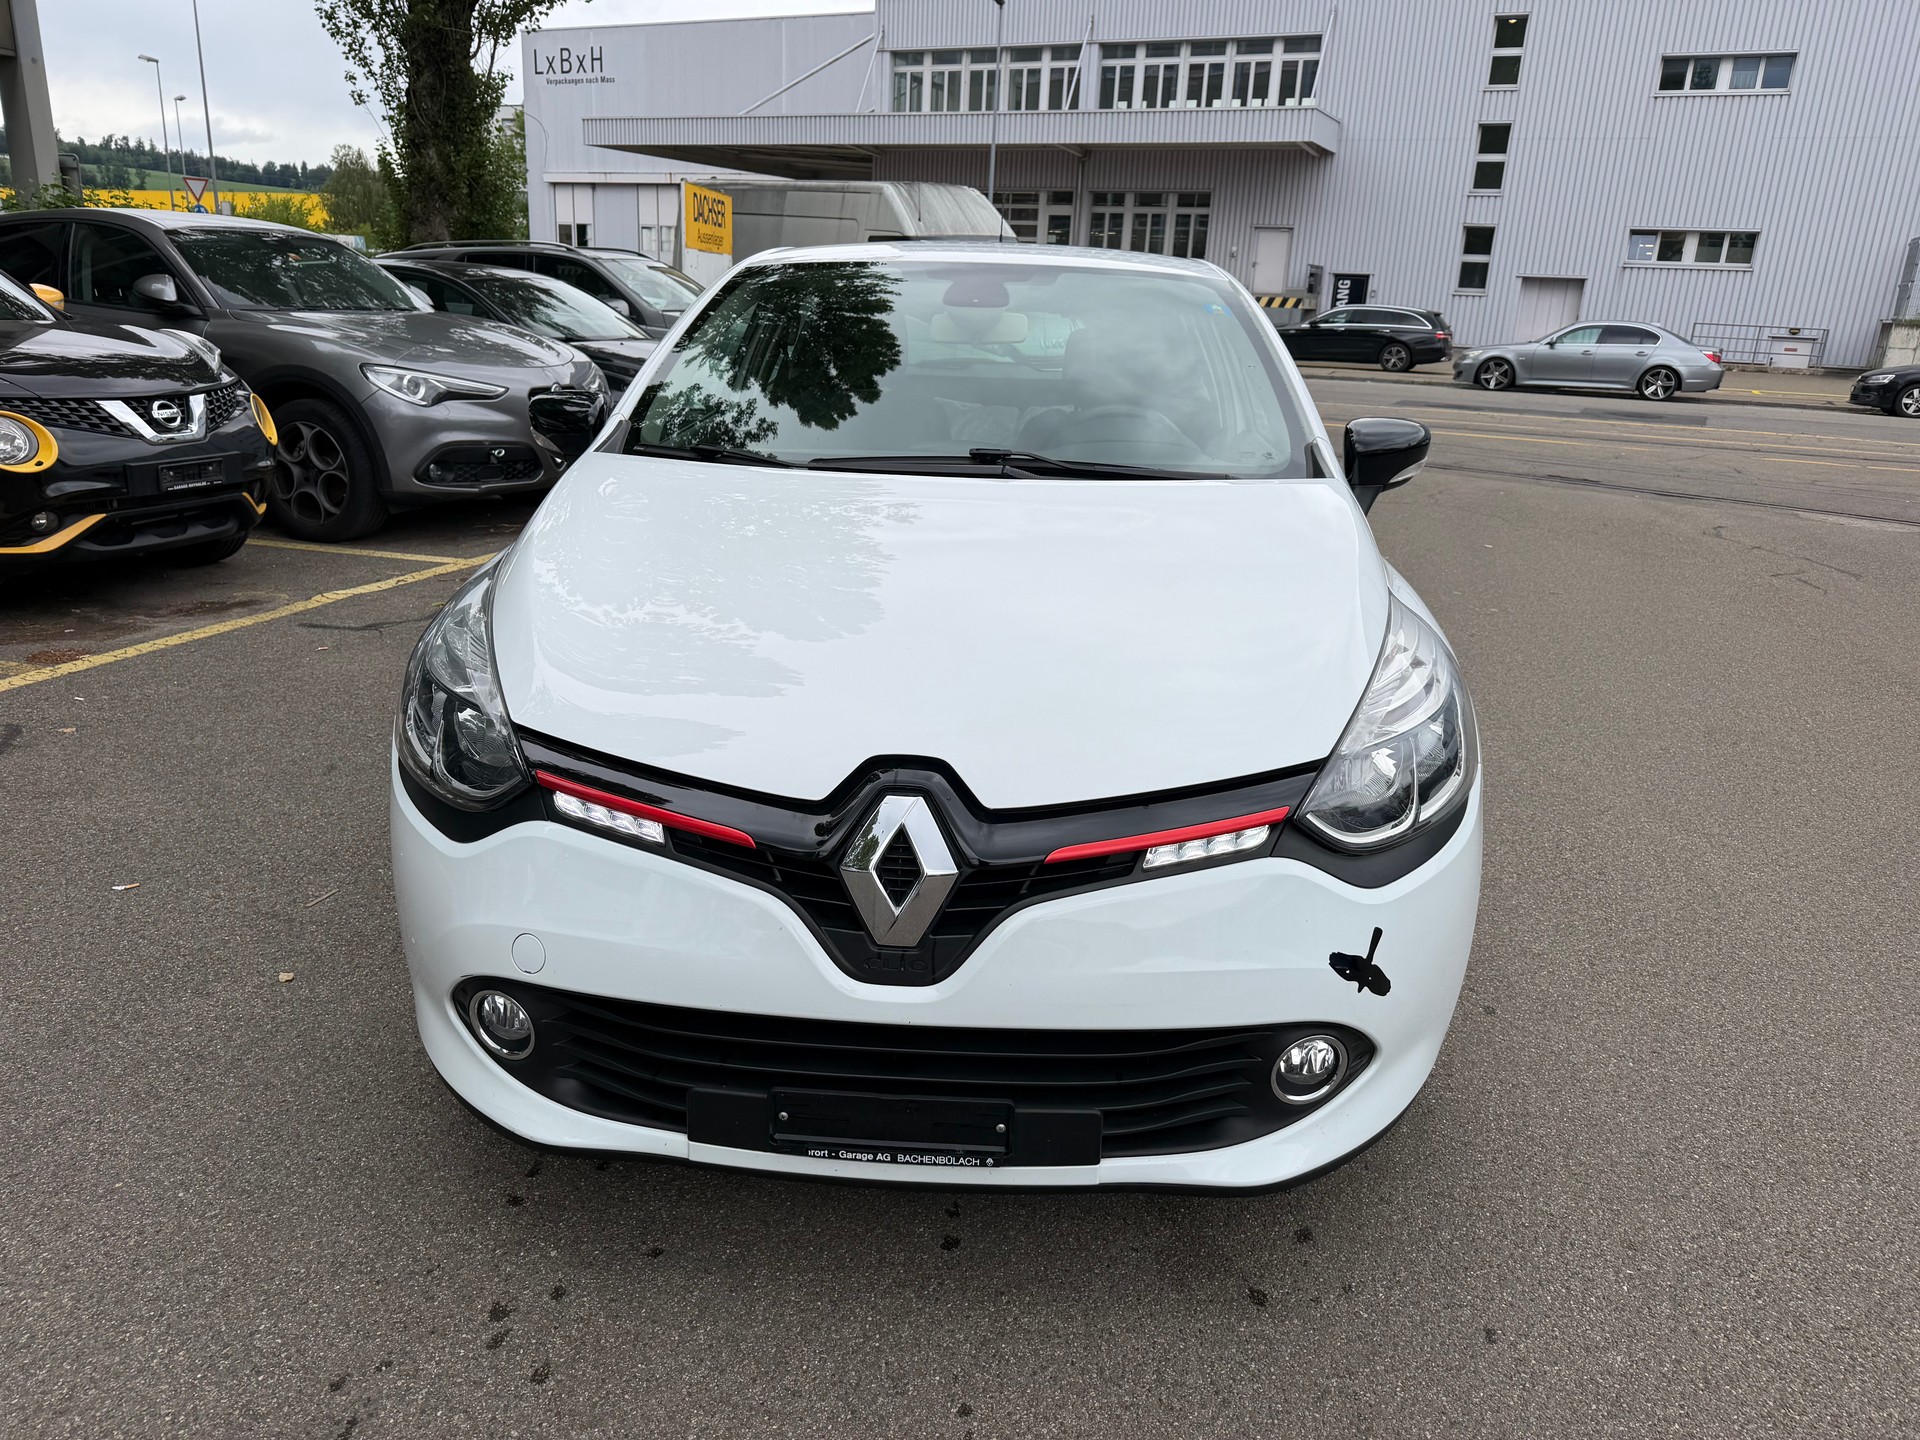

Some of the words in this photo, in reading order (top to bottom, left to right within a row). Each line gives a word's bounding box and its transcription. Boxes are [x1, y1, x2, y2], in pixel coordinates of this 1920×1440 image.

[533, 46, 603, 75] LxBxH
[546, 77, 584, 86] Verpackungen
[586, 76, 599, 84] nach
[600, 75, 616, 84] Mass
[693, 191, 726, 229] DACHSER
[697, 228, 724, 250] Aussenlager
[838, 1150, 874, 1161] Garage
[876, 1153, 891, 1161] AG
[897, 1153, 980, 1166] BACHENBÜLACH
